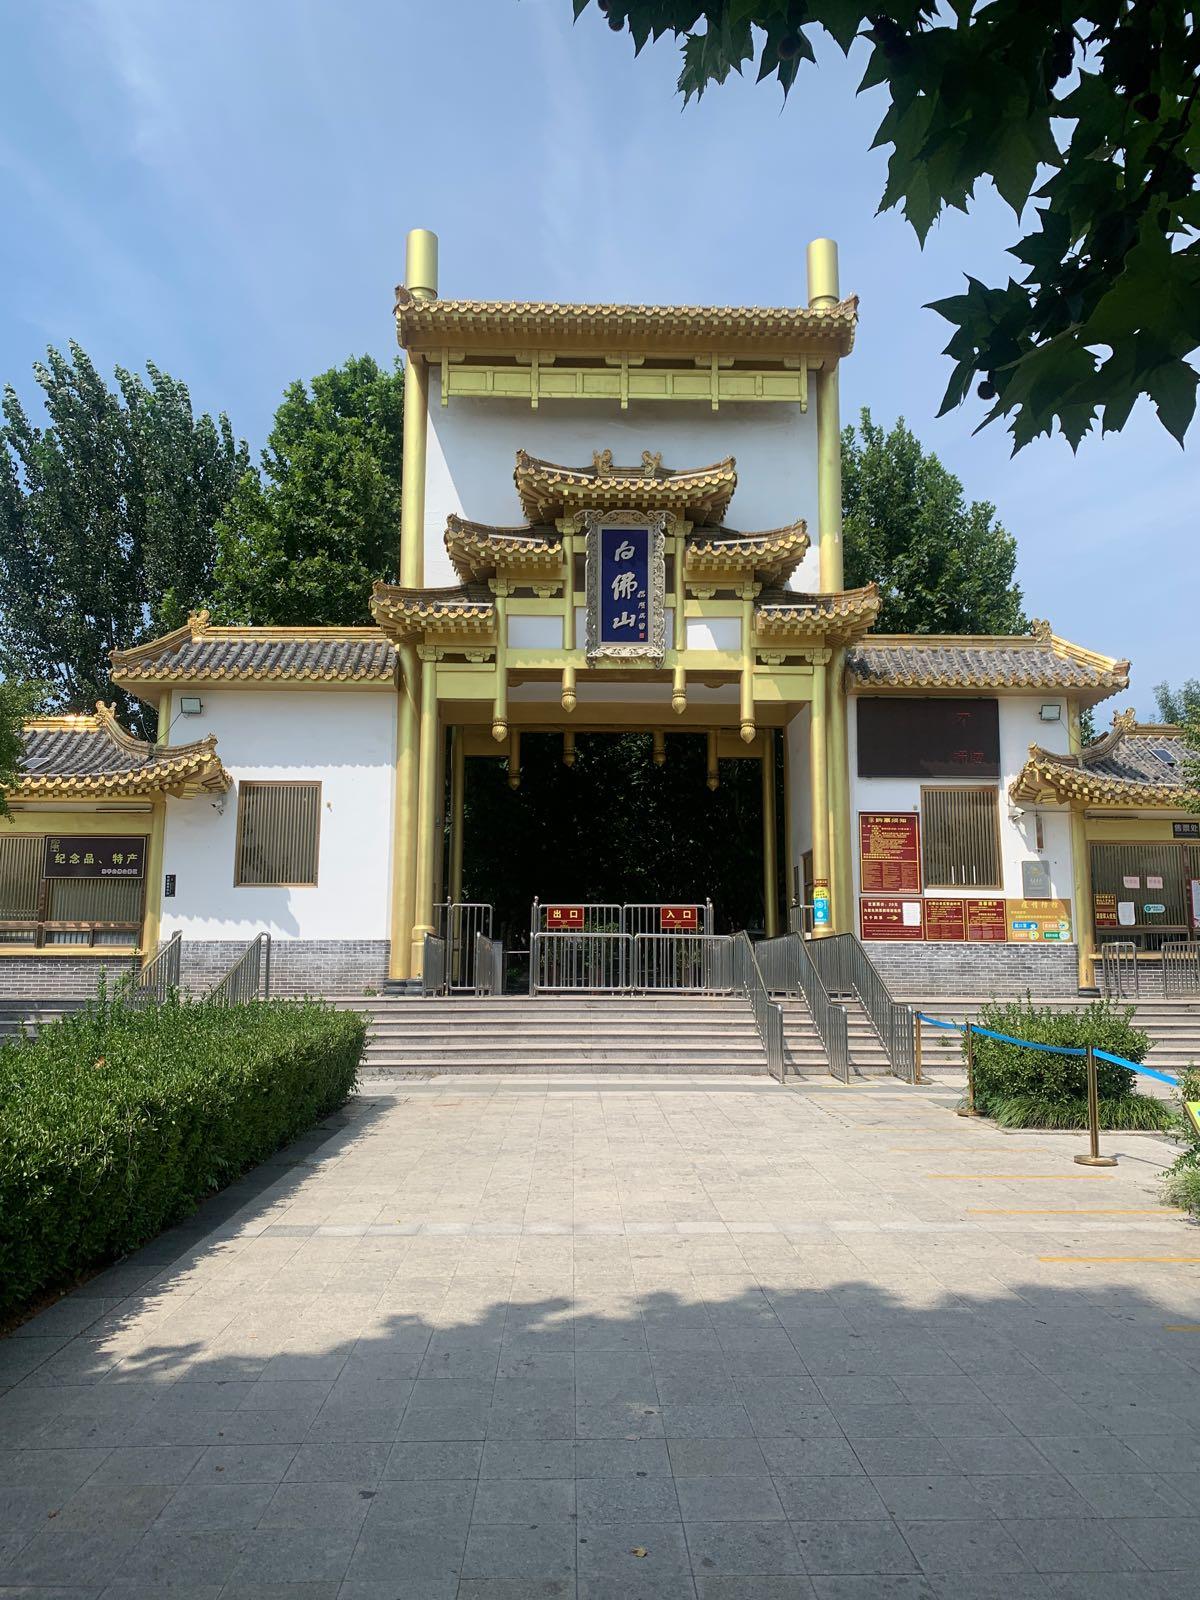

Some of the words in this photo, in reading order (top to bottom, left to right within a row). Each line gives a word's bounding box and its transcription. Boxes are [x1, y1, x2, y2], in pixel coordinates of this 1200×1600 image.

[611, 540, 638, 629] 白佛山
[553, 910, 578, 918] 出口
[666, 910, 691, 919] 入口
